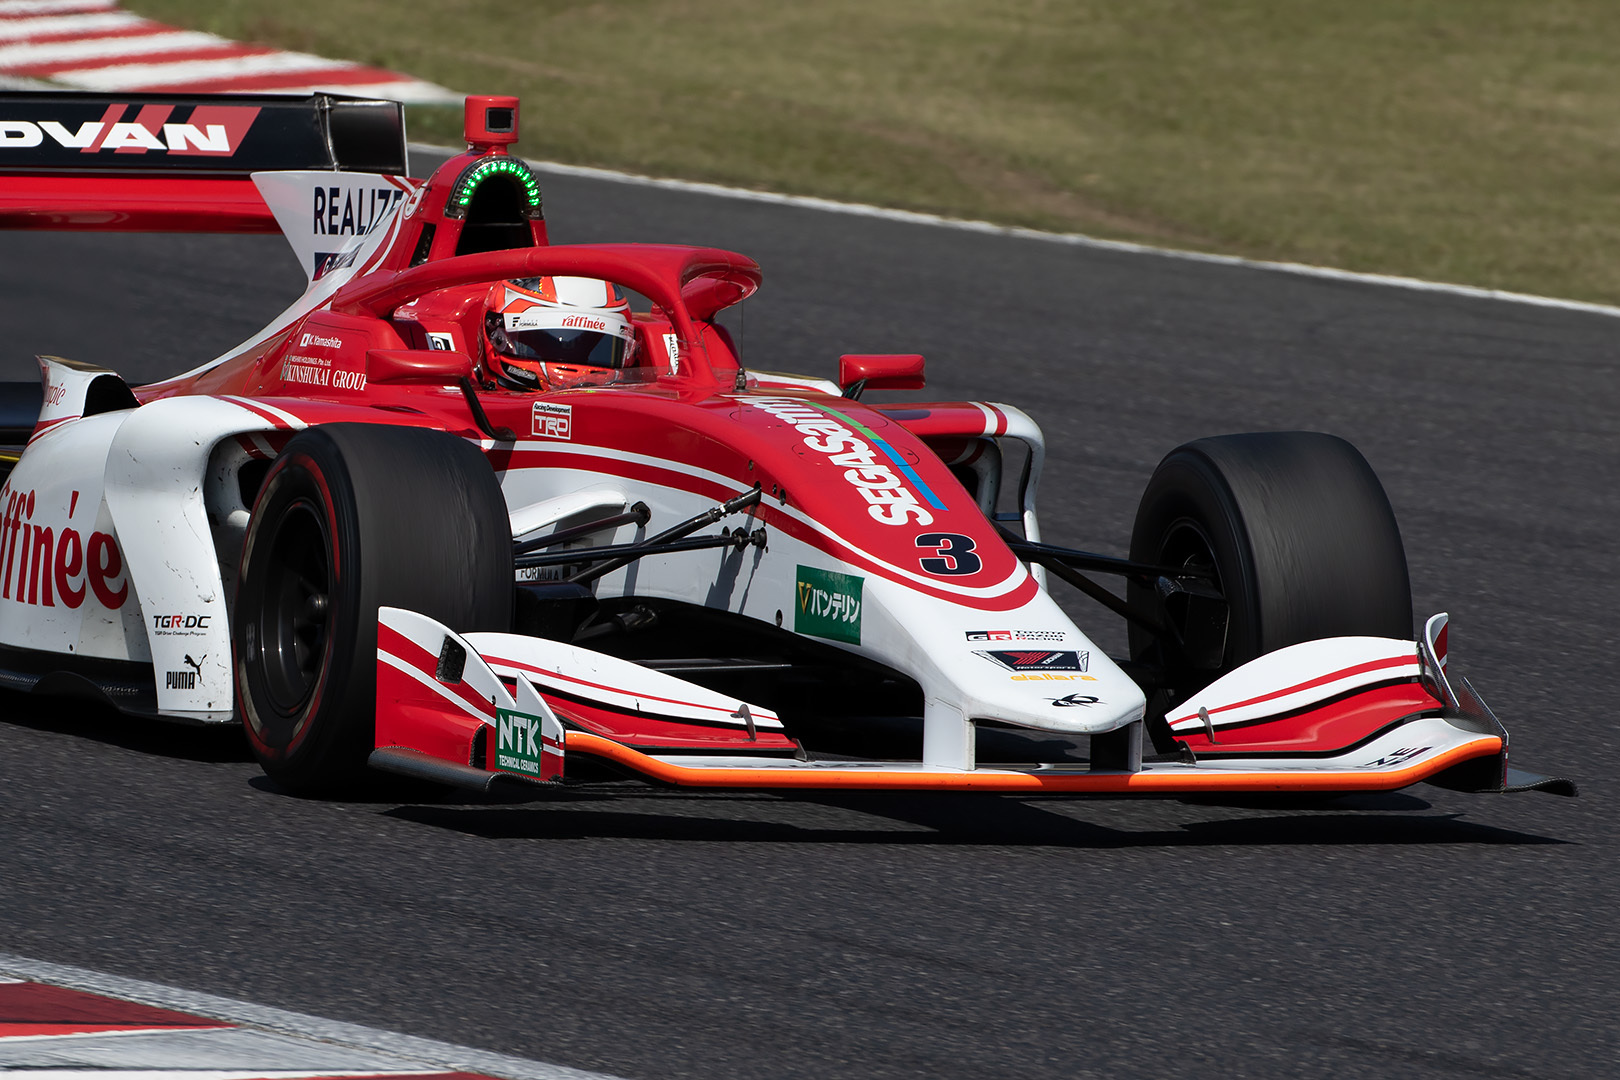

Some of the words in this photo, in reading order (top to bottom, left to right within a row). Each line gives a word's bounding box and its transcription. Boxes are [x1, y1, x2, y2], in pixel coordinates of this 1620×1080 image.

[562, 315, 606, 330] raffinée
[535, 415, 569, 437] TRD
[914, 532, 983, 577] 3
[811, 588, 860, 624] バンテリン
[166, 671, 196, 690] PUMA
[1010, 673, 1098, 681] dallara
[499, 714, 539, 758] NTK
